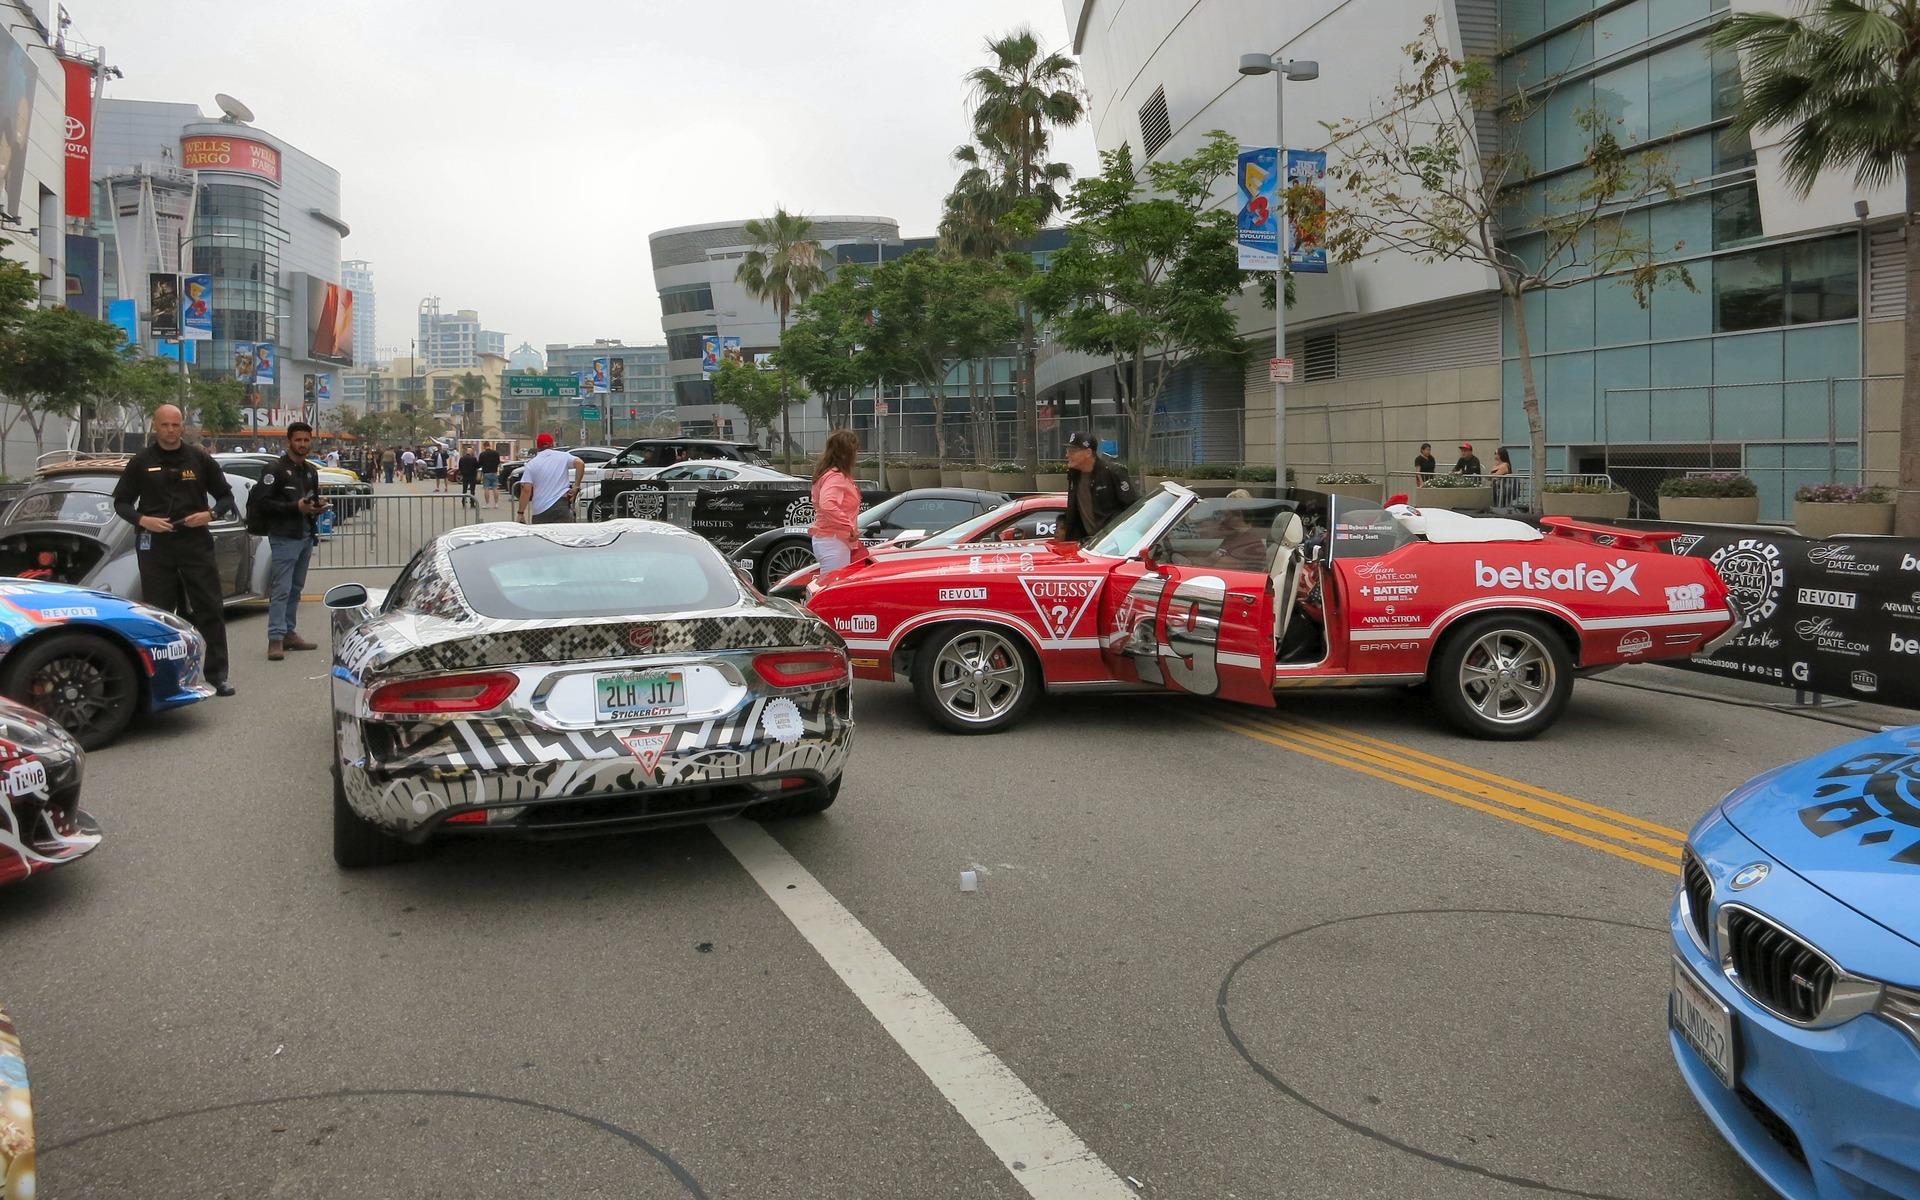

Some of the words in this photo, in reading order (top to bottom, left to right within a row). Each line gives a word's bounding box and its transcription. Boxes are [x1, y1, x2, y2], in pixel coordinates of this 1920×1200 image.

[185, 140, 231, 153] WELLS
[185, 153, 231, 165] FARGO
[250, 145, 276, 165] WELLS
[250, 157, 276, 176] FARGO
[1295, 160, 1318, 169] JUST
[692, 519, 734, 528] HRISTIE'S
[1827, 560, 1880, 572] DATE.COM
[1375, 573, 1417, 581] DATE.COM
[1475, 559, 1609, 592] betsafe
[940, 588, 986, 600] REVOLT
[1032, 581, 1088, 598] GUESS
[1373, 585, 1419, 595] BATTERY
[1664, 583, 1706, 601] TOP
[1799, 589, 1855, 607] REVOLT
[1667, 598, 1706, 612] TRUMPS
[1881, 602, 1915, 613] ARMIN
[42, 607, 98, 619] REVOLT
[1391, 615, 1421, 623] STROM
[833, 615, 878, 634] YouTube
[1794, 615, 1844, 641] Asian
[1360, 642, 1420, 651] BRAVEN
[1817, 637, 1869, 652] DATE.COM
[1854, 674, 1874, 684] STEEL
[606, 684, 637, 708] 2LH
[647, 681, 675, 704] J17
[629, 738, 664, 748] GUESS
